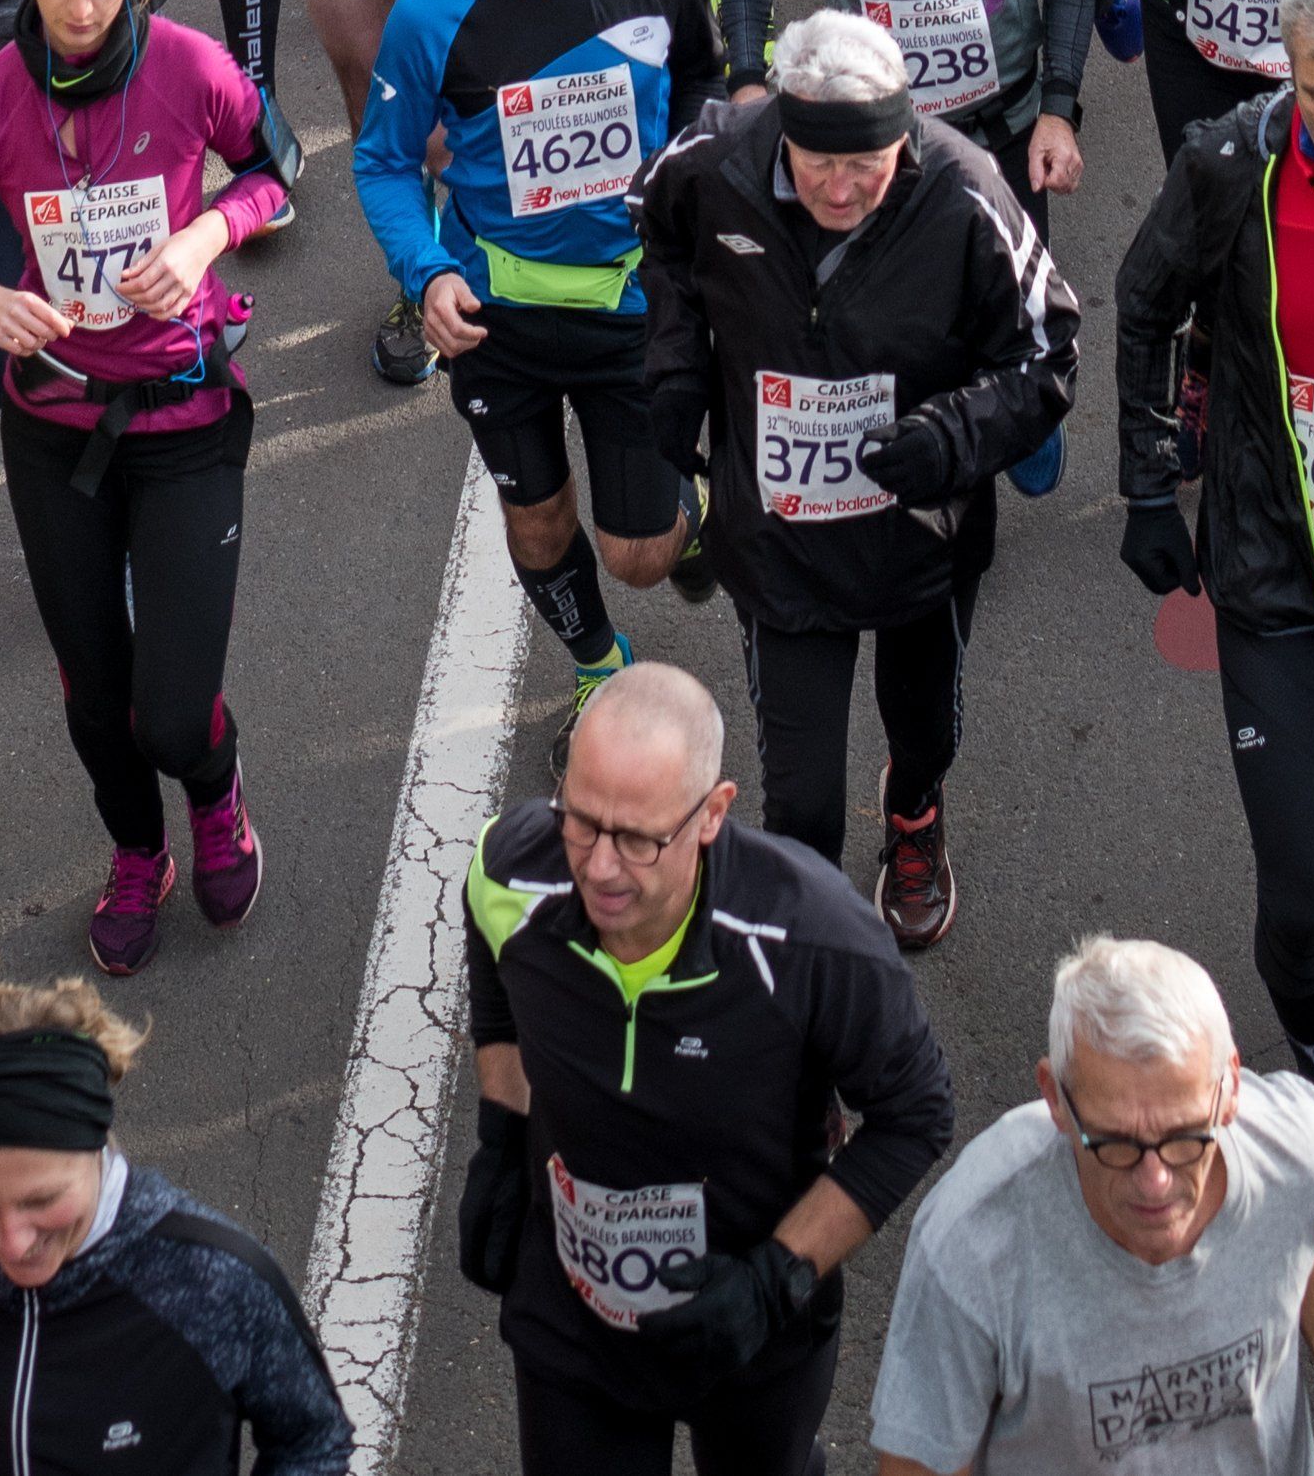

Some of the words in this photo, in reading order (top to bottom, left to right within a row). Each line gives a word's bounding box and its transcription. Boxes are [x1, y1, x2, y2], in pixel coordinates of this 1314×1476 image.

[898, 7, 981, 29] D'EPARGNE
[908, 42, 990, 89] 238
[556, 72, 608, 92] CAISSE
[942, 81, 996, 105] balance
[541, 85, 628, 110] D'EPARGNE
[572, 106, 628, 128] BEAUNOISES
[512, 121, 632, 179] 4620
[87, 183, 141, 203] CAISSE
[553, 186, 581, 205] new
[70, 199, 161, 223] D'EPARGNE
[817, 379, 871, 396] CAISSE
[798, 392, 889, 414] D'EPARGNE
[803, 499, 832, 517] new
[604, 1185, 674, 1208] CAISSE
[582, 1200, 699, 1224] D'EPARGNE
